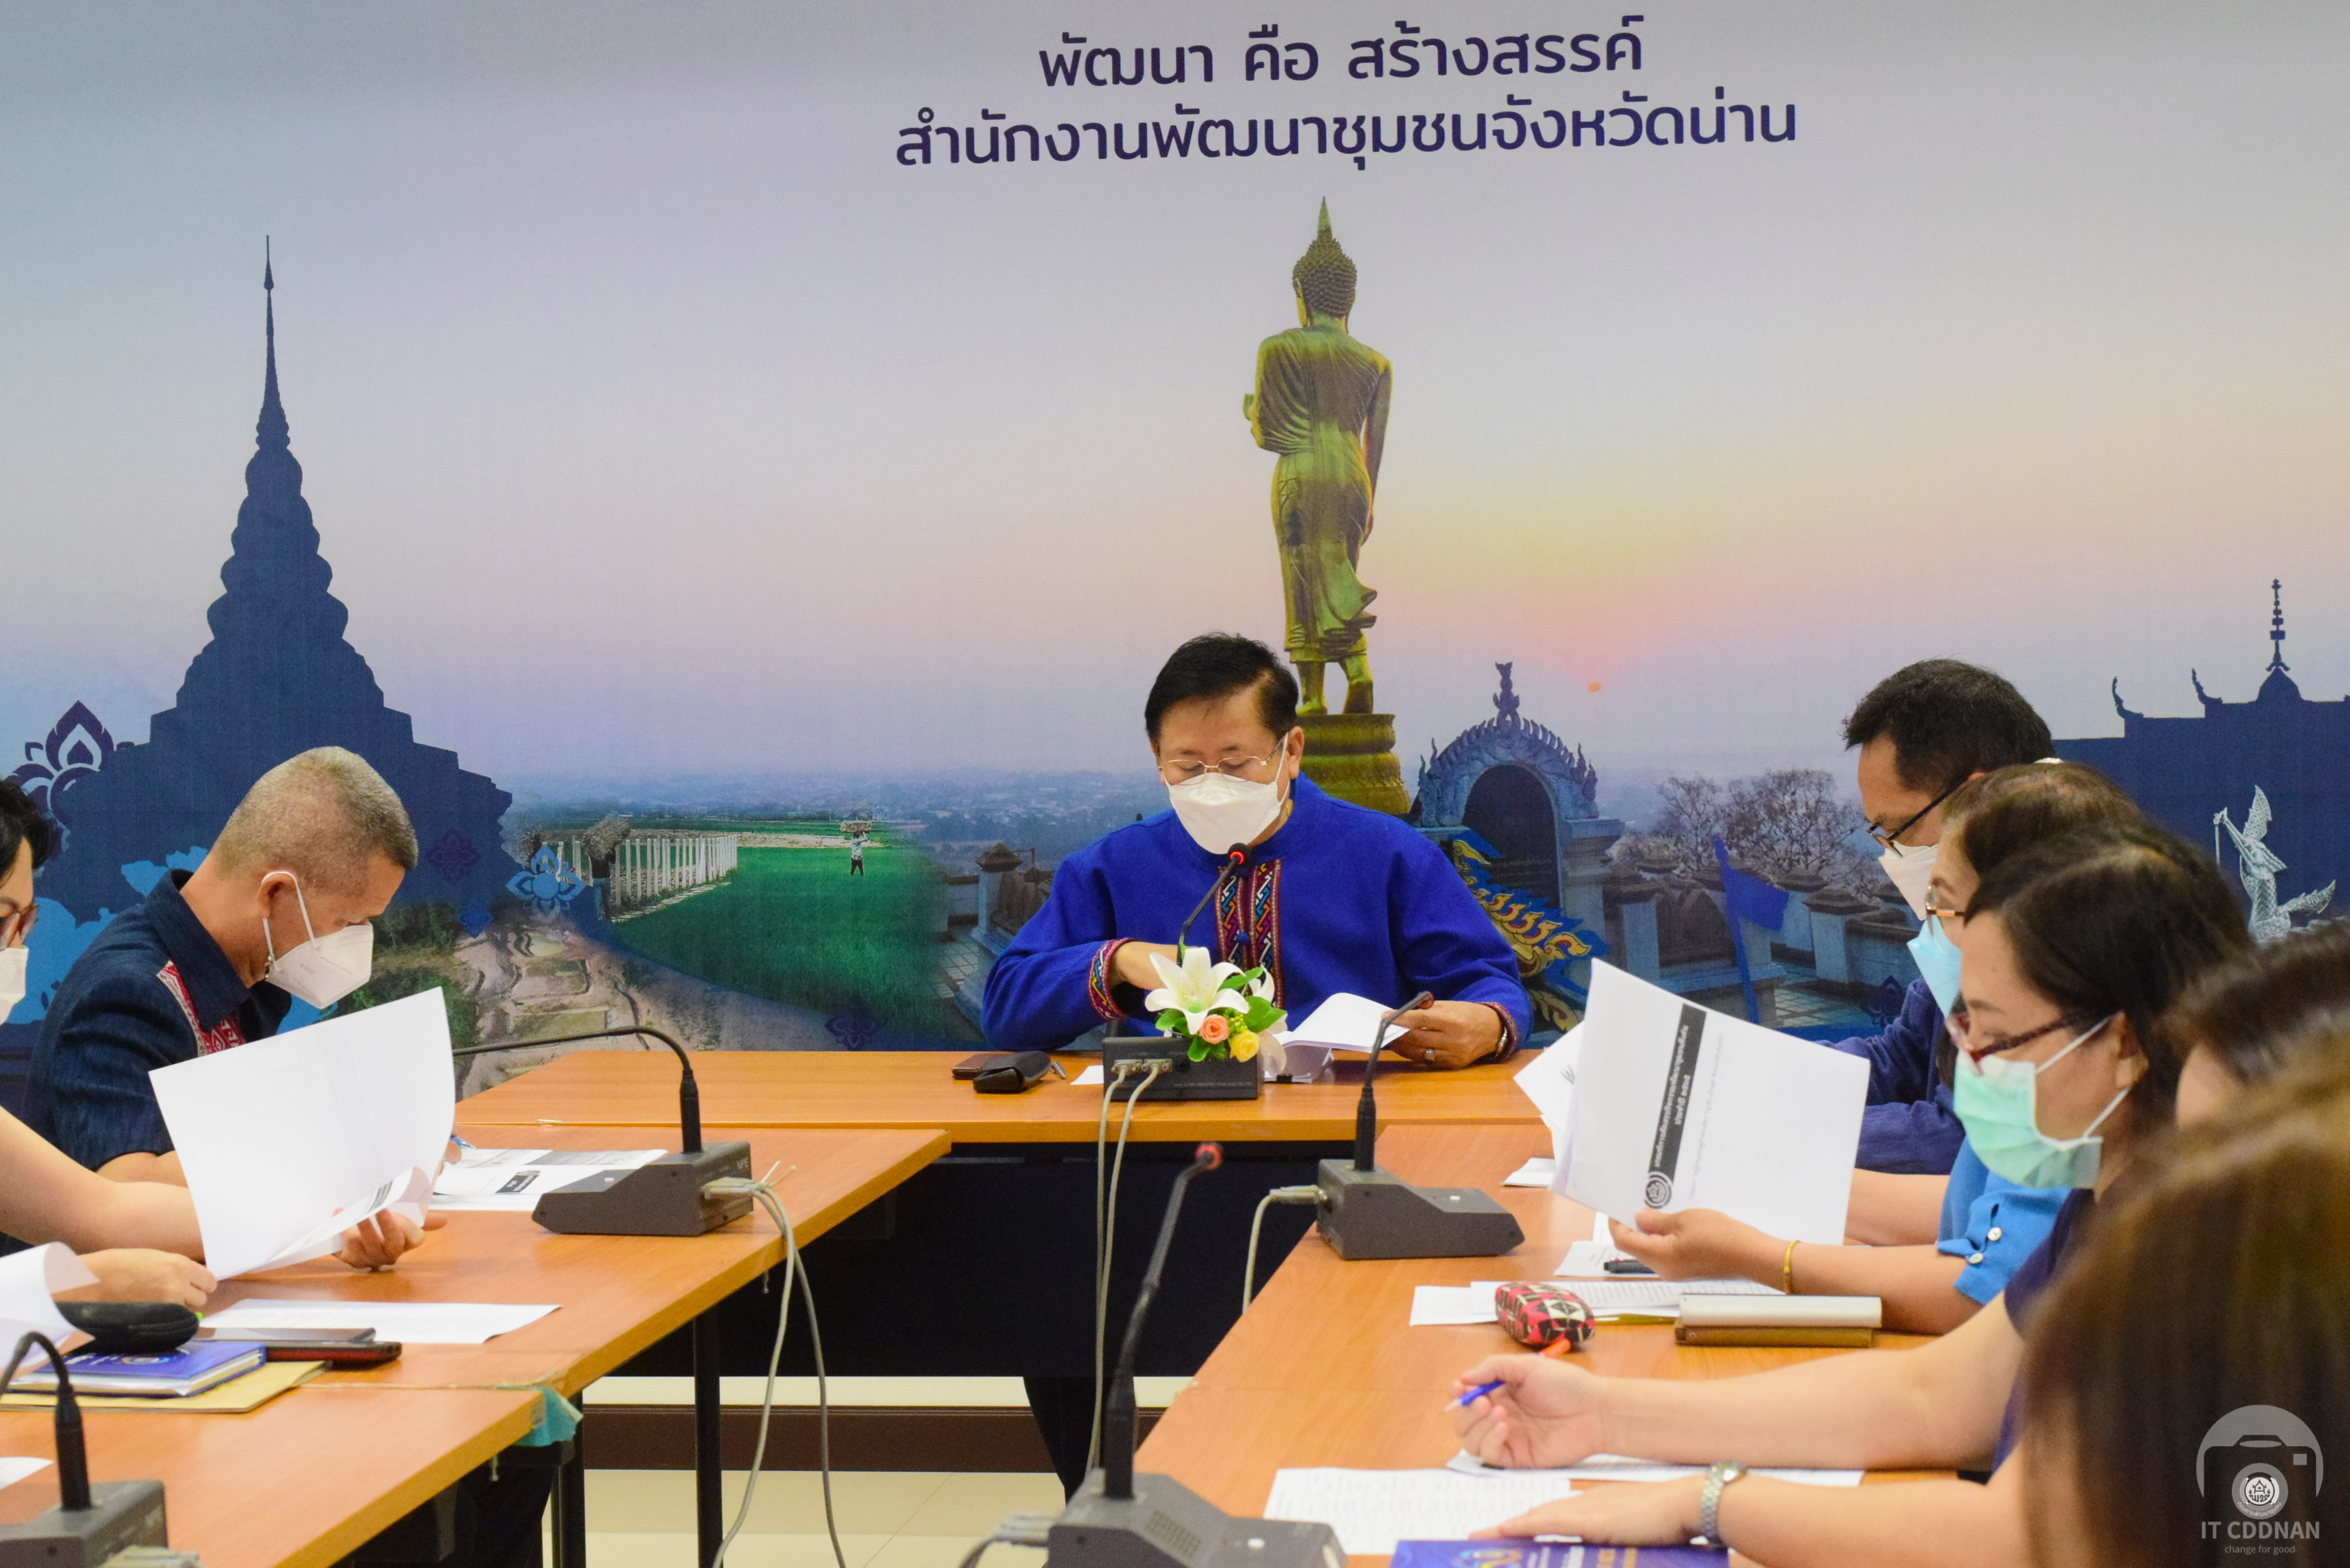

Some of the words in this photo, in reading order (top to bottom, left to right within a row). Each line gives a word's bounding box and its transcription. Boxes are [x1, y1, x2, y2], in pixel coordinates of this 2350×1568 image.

[1038, 31, 1213, 87] พัฒนา
[1245, 24, 1319, 82] คือ
[1348, 15, 1644, 79] สร้างสรรค์
[896, 86, 1795, 171] สำนักงานพัฒนาชุมชนจังหวัดน่าน
